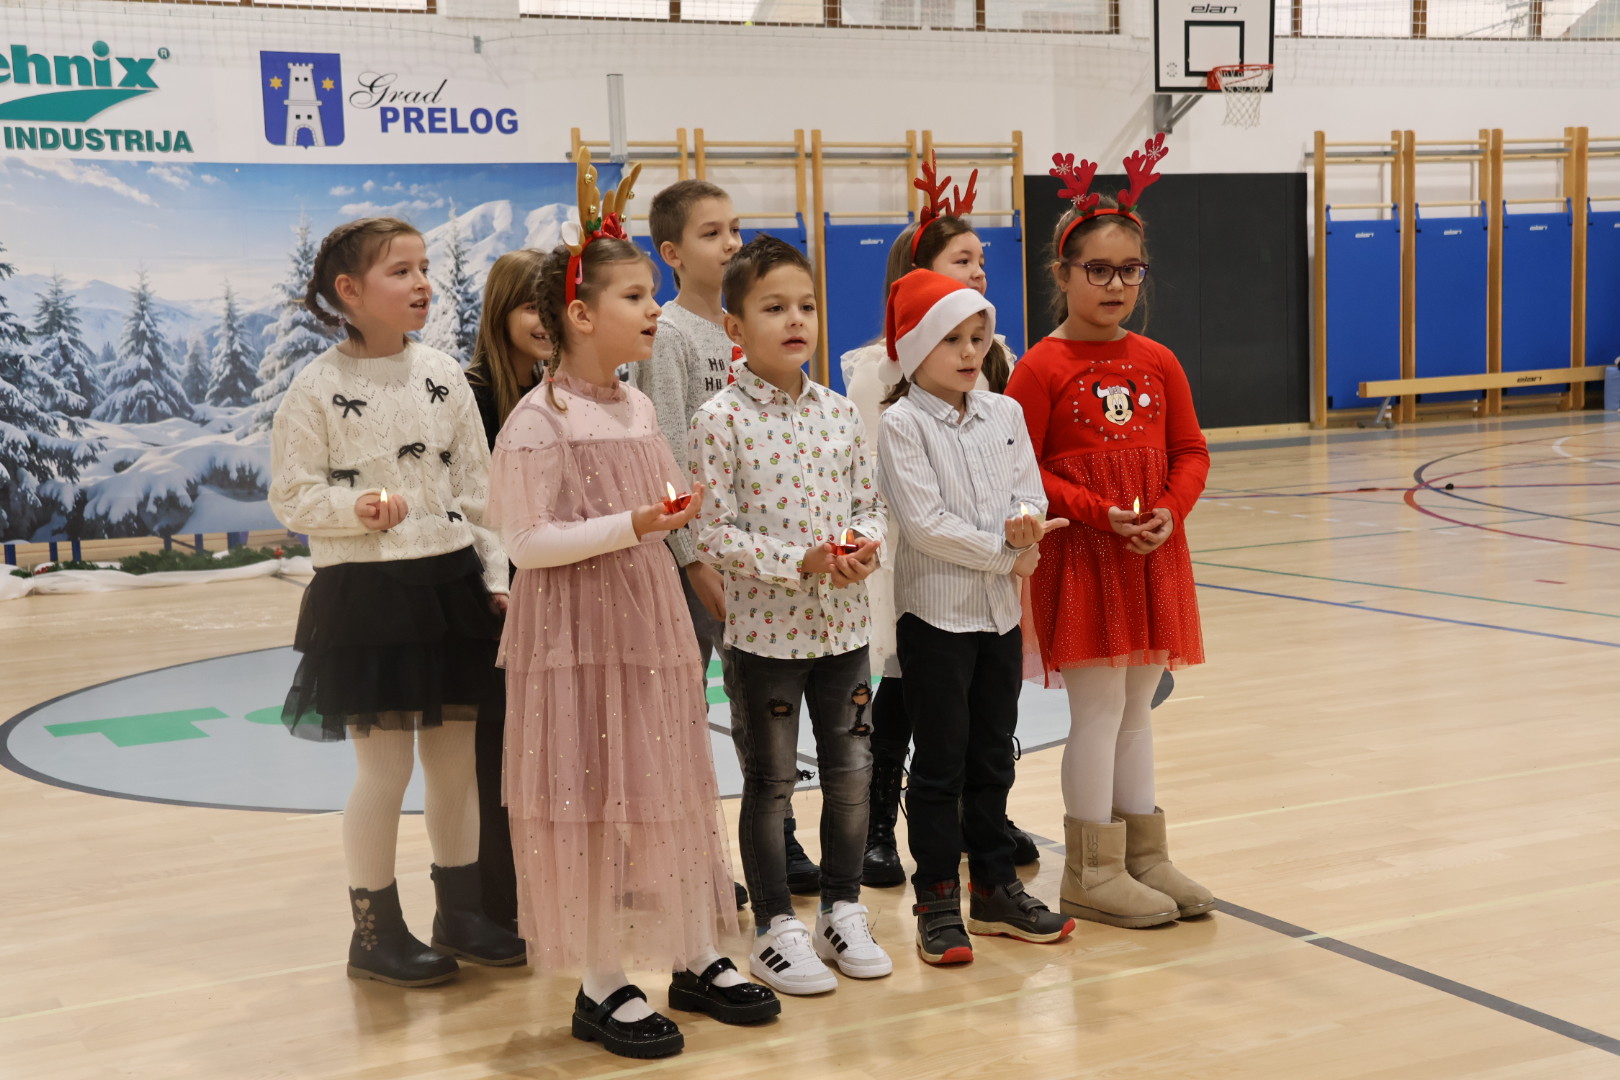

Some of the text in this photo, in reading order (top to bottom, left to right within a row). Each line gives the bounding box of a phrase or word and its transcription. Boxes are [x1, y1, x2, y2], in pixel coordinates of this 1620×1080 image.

[1191, 3, 1238, 14] elan
[349, 71, 448, 110] Grad
[380, 106, 519, 134] PRELOG
[3, 126, 194, 153] INDUSTRIJA
